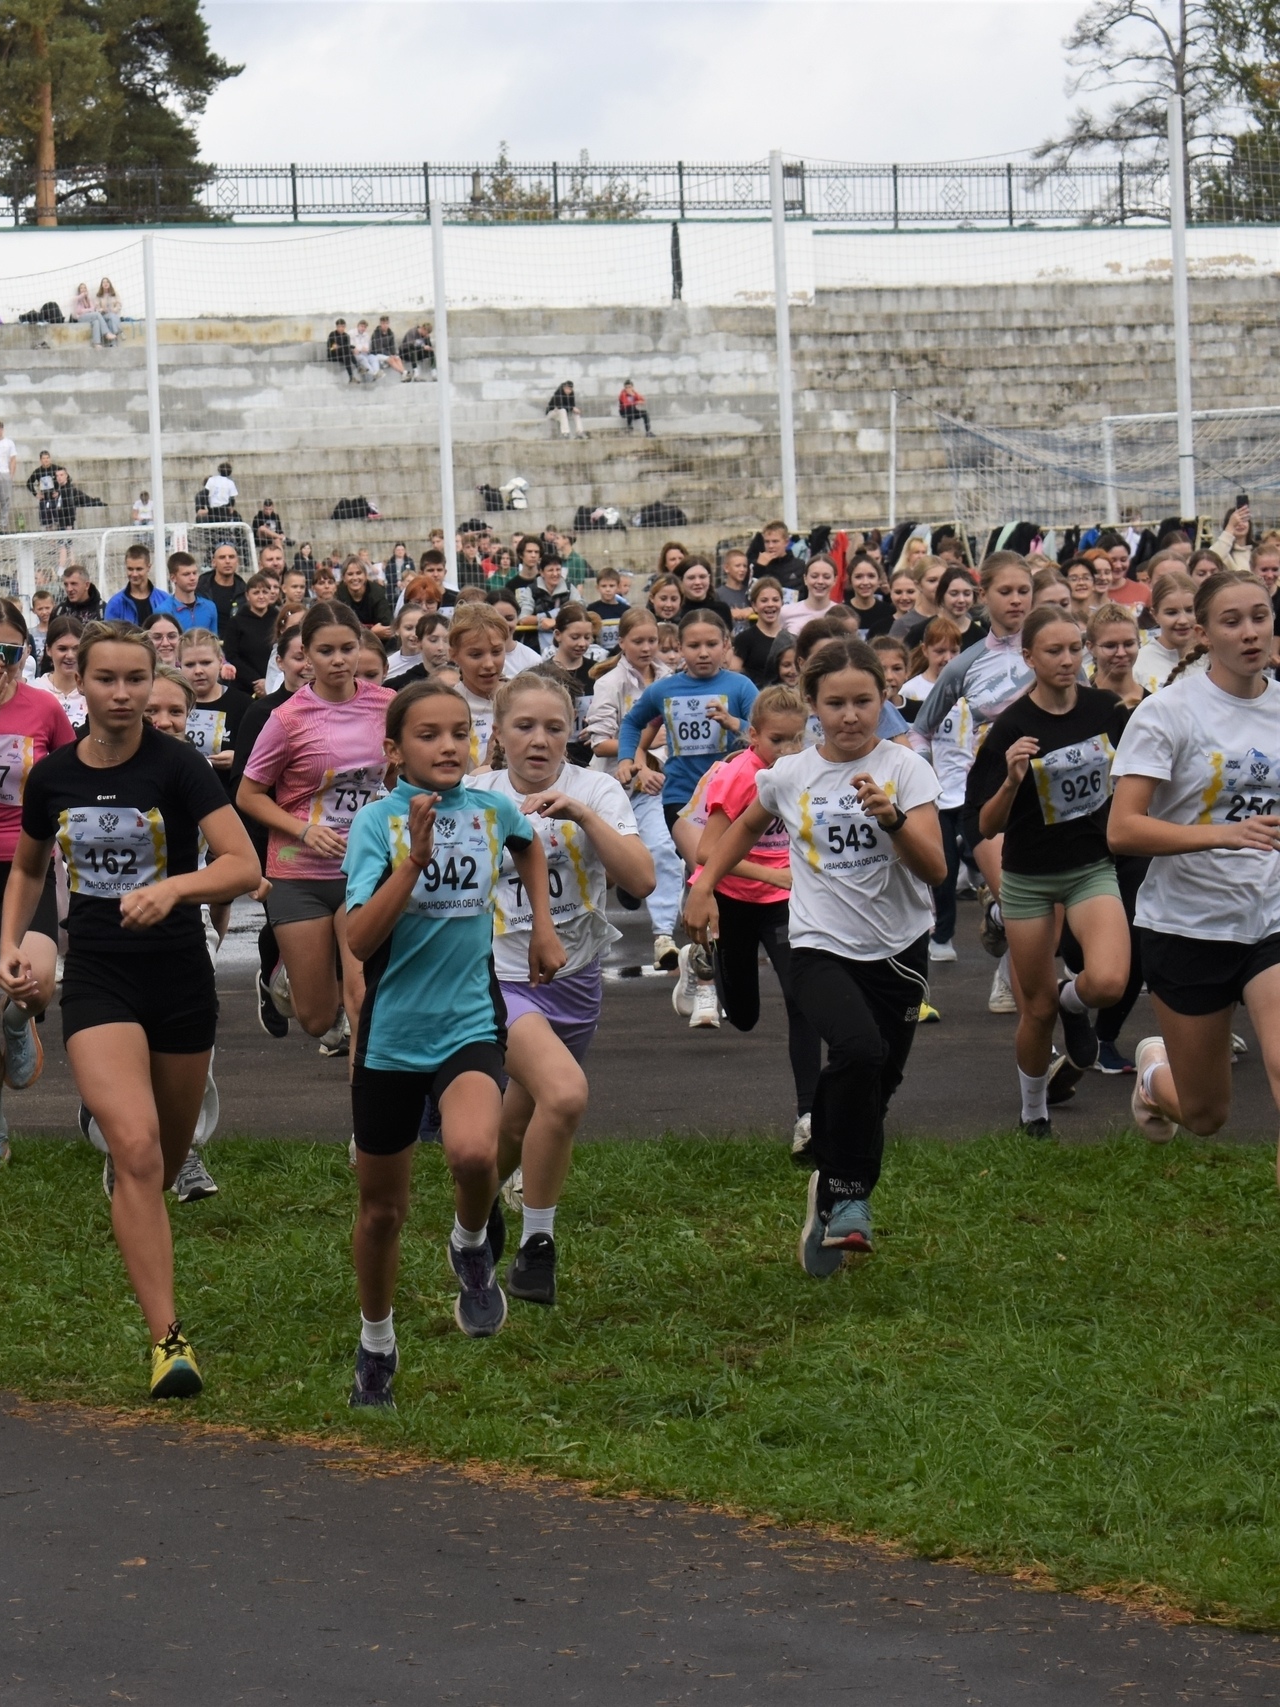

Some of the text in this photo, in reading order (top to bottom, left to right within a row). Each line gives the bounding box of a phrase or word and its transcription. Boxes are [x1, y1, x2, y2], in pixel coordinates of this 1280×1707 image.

[678, 720, 711, 741] 683
[1061, 770, 1101, 803] 926
[335, 787, 371, 812] 737
[325, 815, 353, 824] ИВАНОВСКА
[828, 823, 877, 854] 543
[84, 848, 138, 875] 162
[422, 855, 479, 893] 942
[823, 854, 889, 870] ИВАНОВСКАЯ ОБЛАСТЬ
[84, 880, 121, 890] ИВАНОВСКАЯ
[507, 868, 563, 908] 70
[418, 899, 462, 910] ИВАНОВСКАЯ
